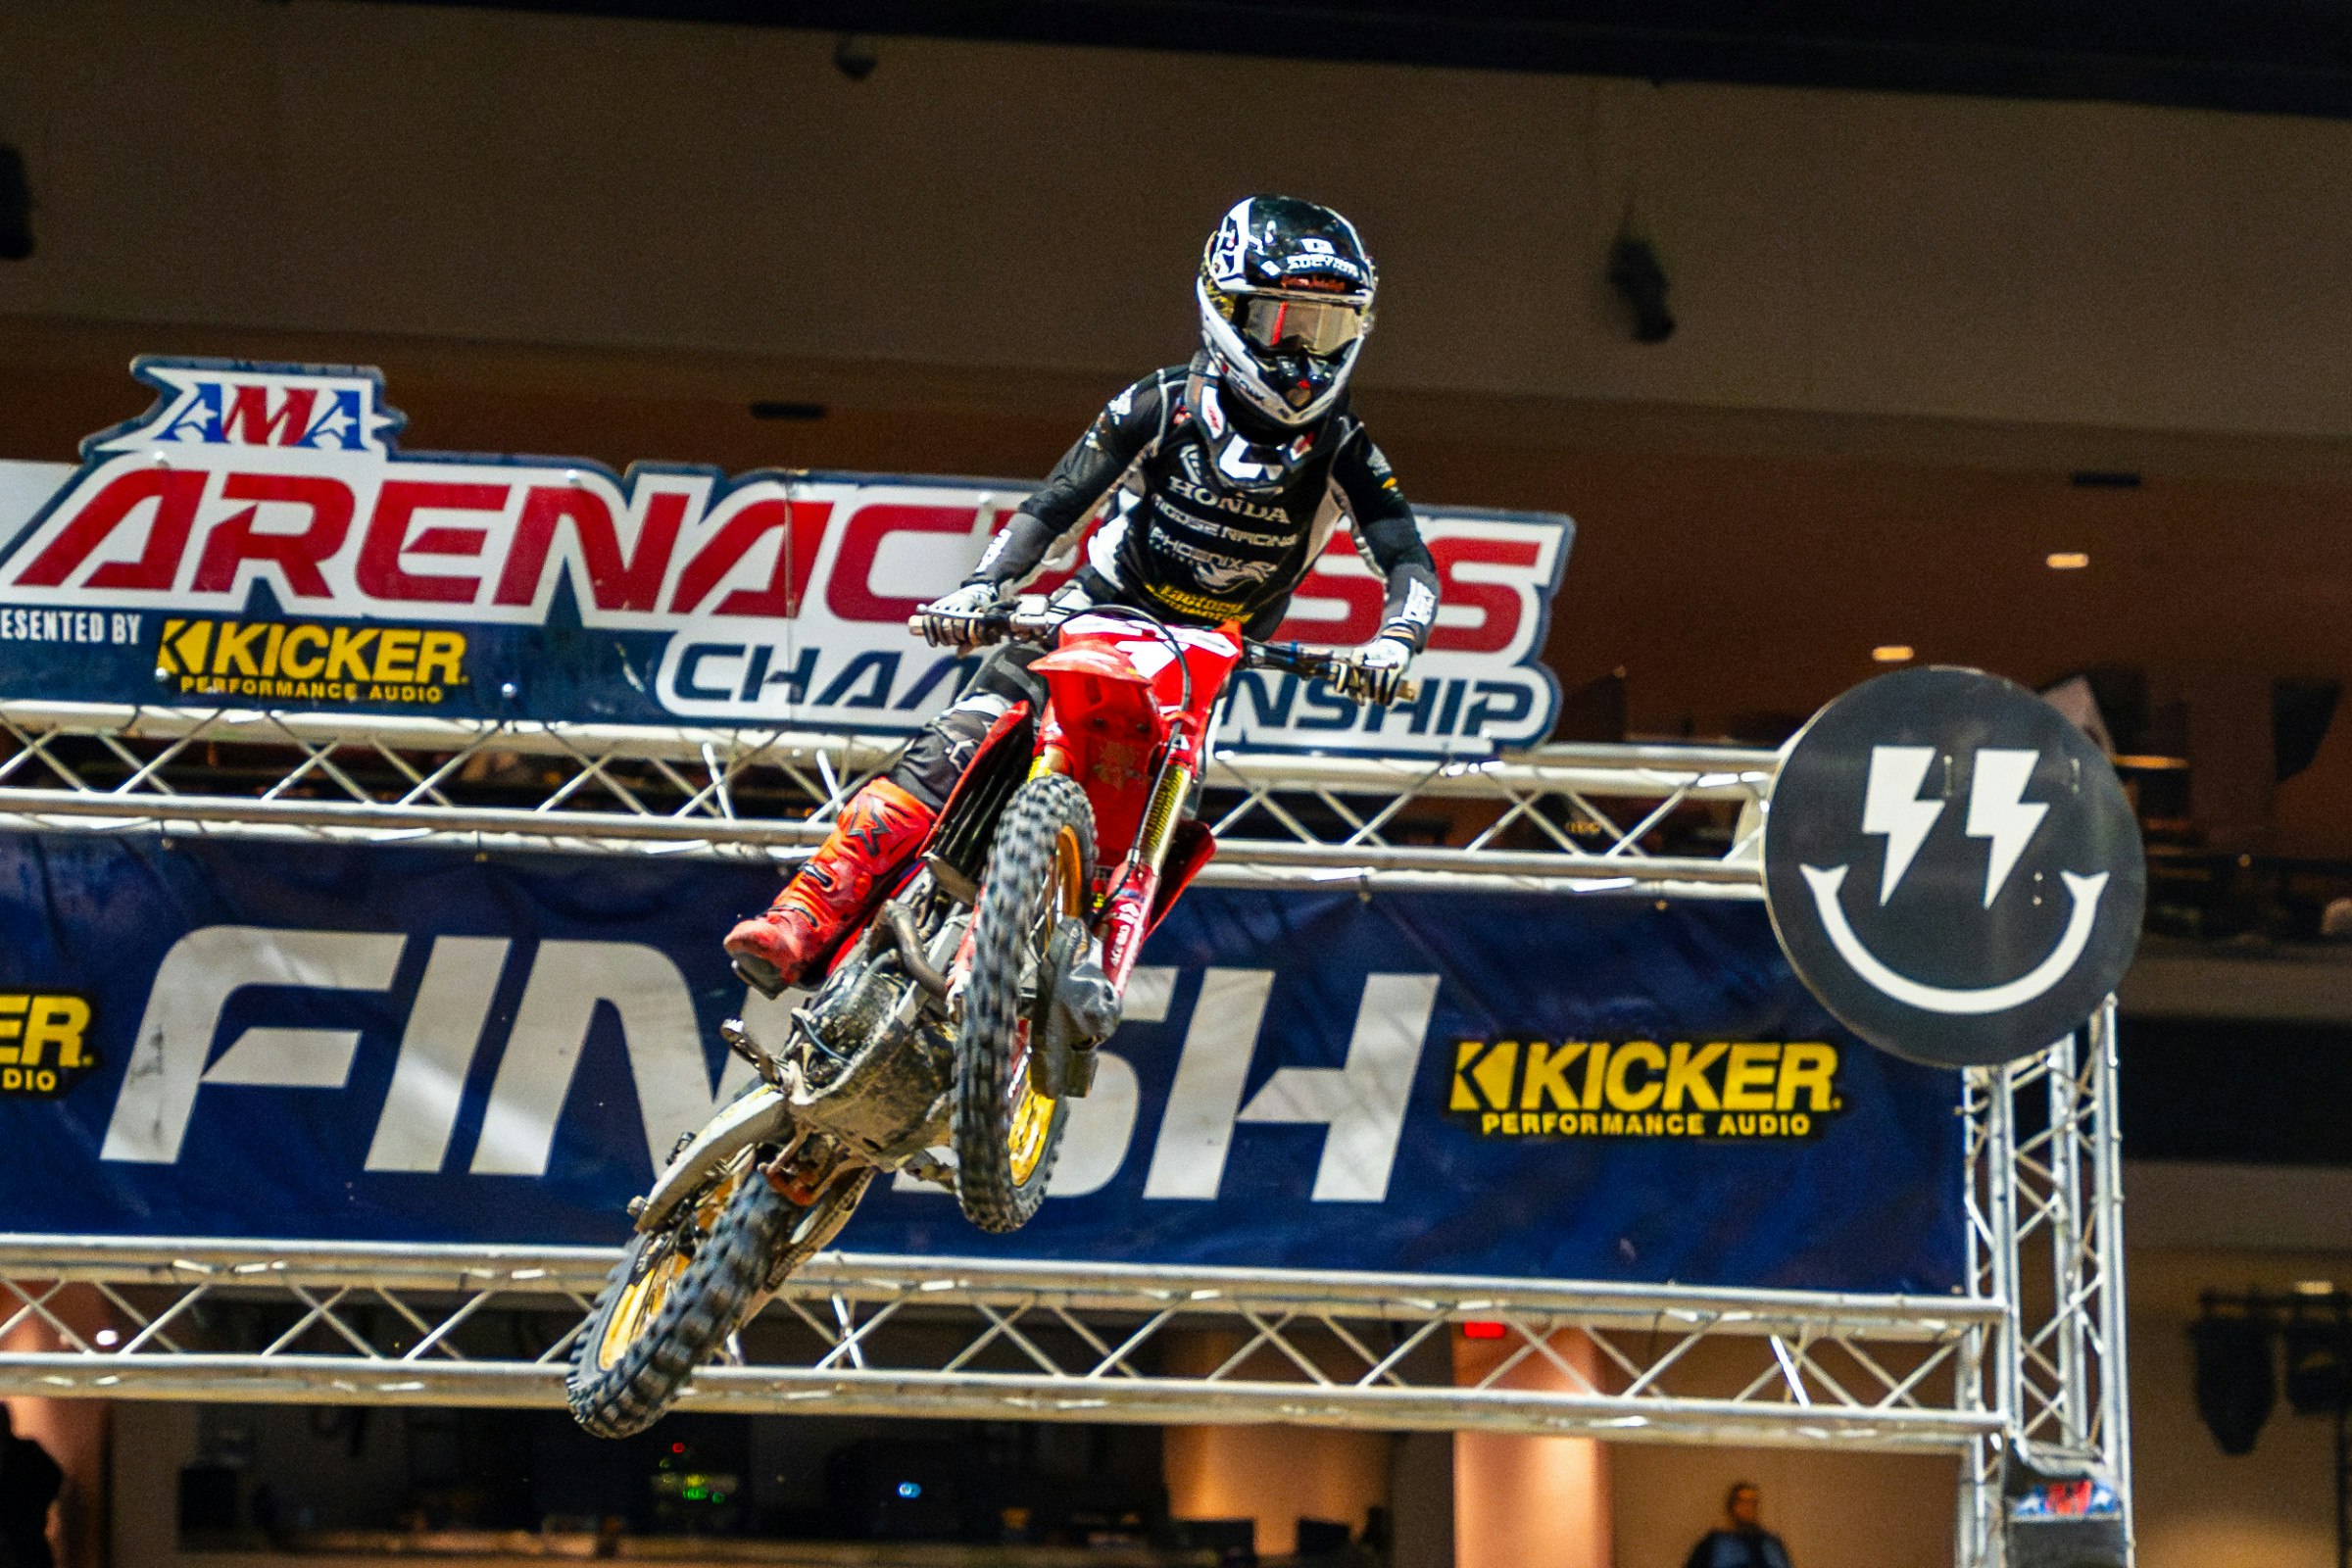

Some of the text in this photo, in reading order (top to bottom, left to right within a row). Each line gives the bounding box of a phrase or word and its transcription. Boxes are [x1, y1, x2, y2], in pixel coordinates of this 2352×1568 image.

[151, 382, 369, 451] AMA
[12, 468, 1542, 653] ARENACSS
[0, 609, 142, 645] ESENTED BY
[211, 620, 467, 685] KICKER
[179, 675, 443, 704] PERFORMANCE AUDIO
[673, 642, 1534, 736] CHANSHIP
[99, 924, 1441, 1203] FINSH
[1519, 1040, 1839, 1112] KICKER
[1482, 1113, 1811, 1137] PERFORMANCE AUDIO
